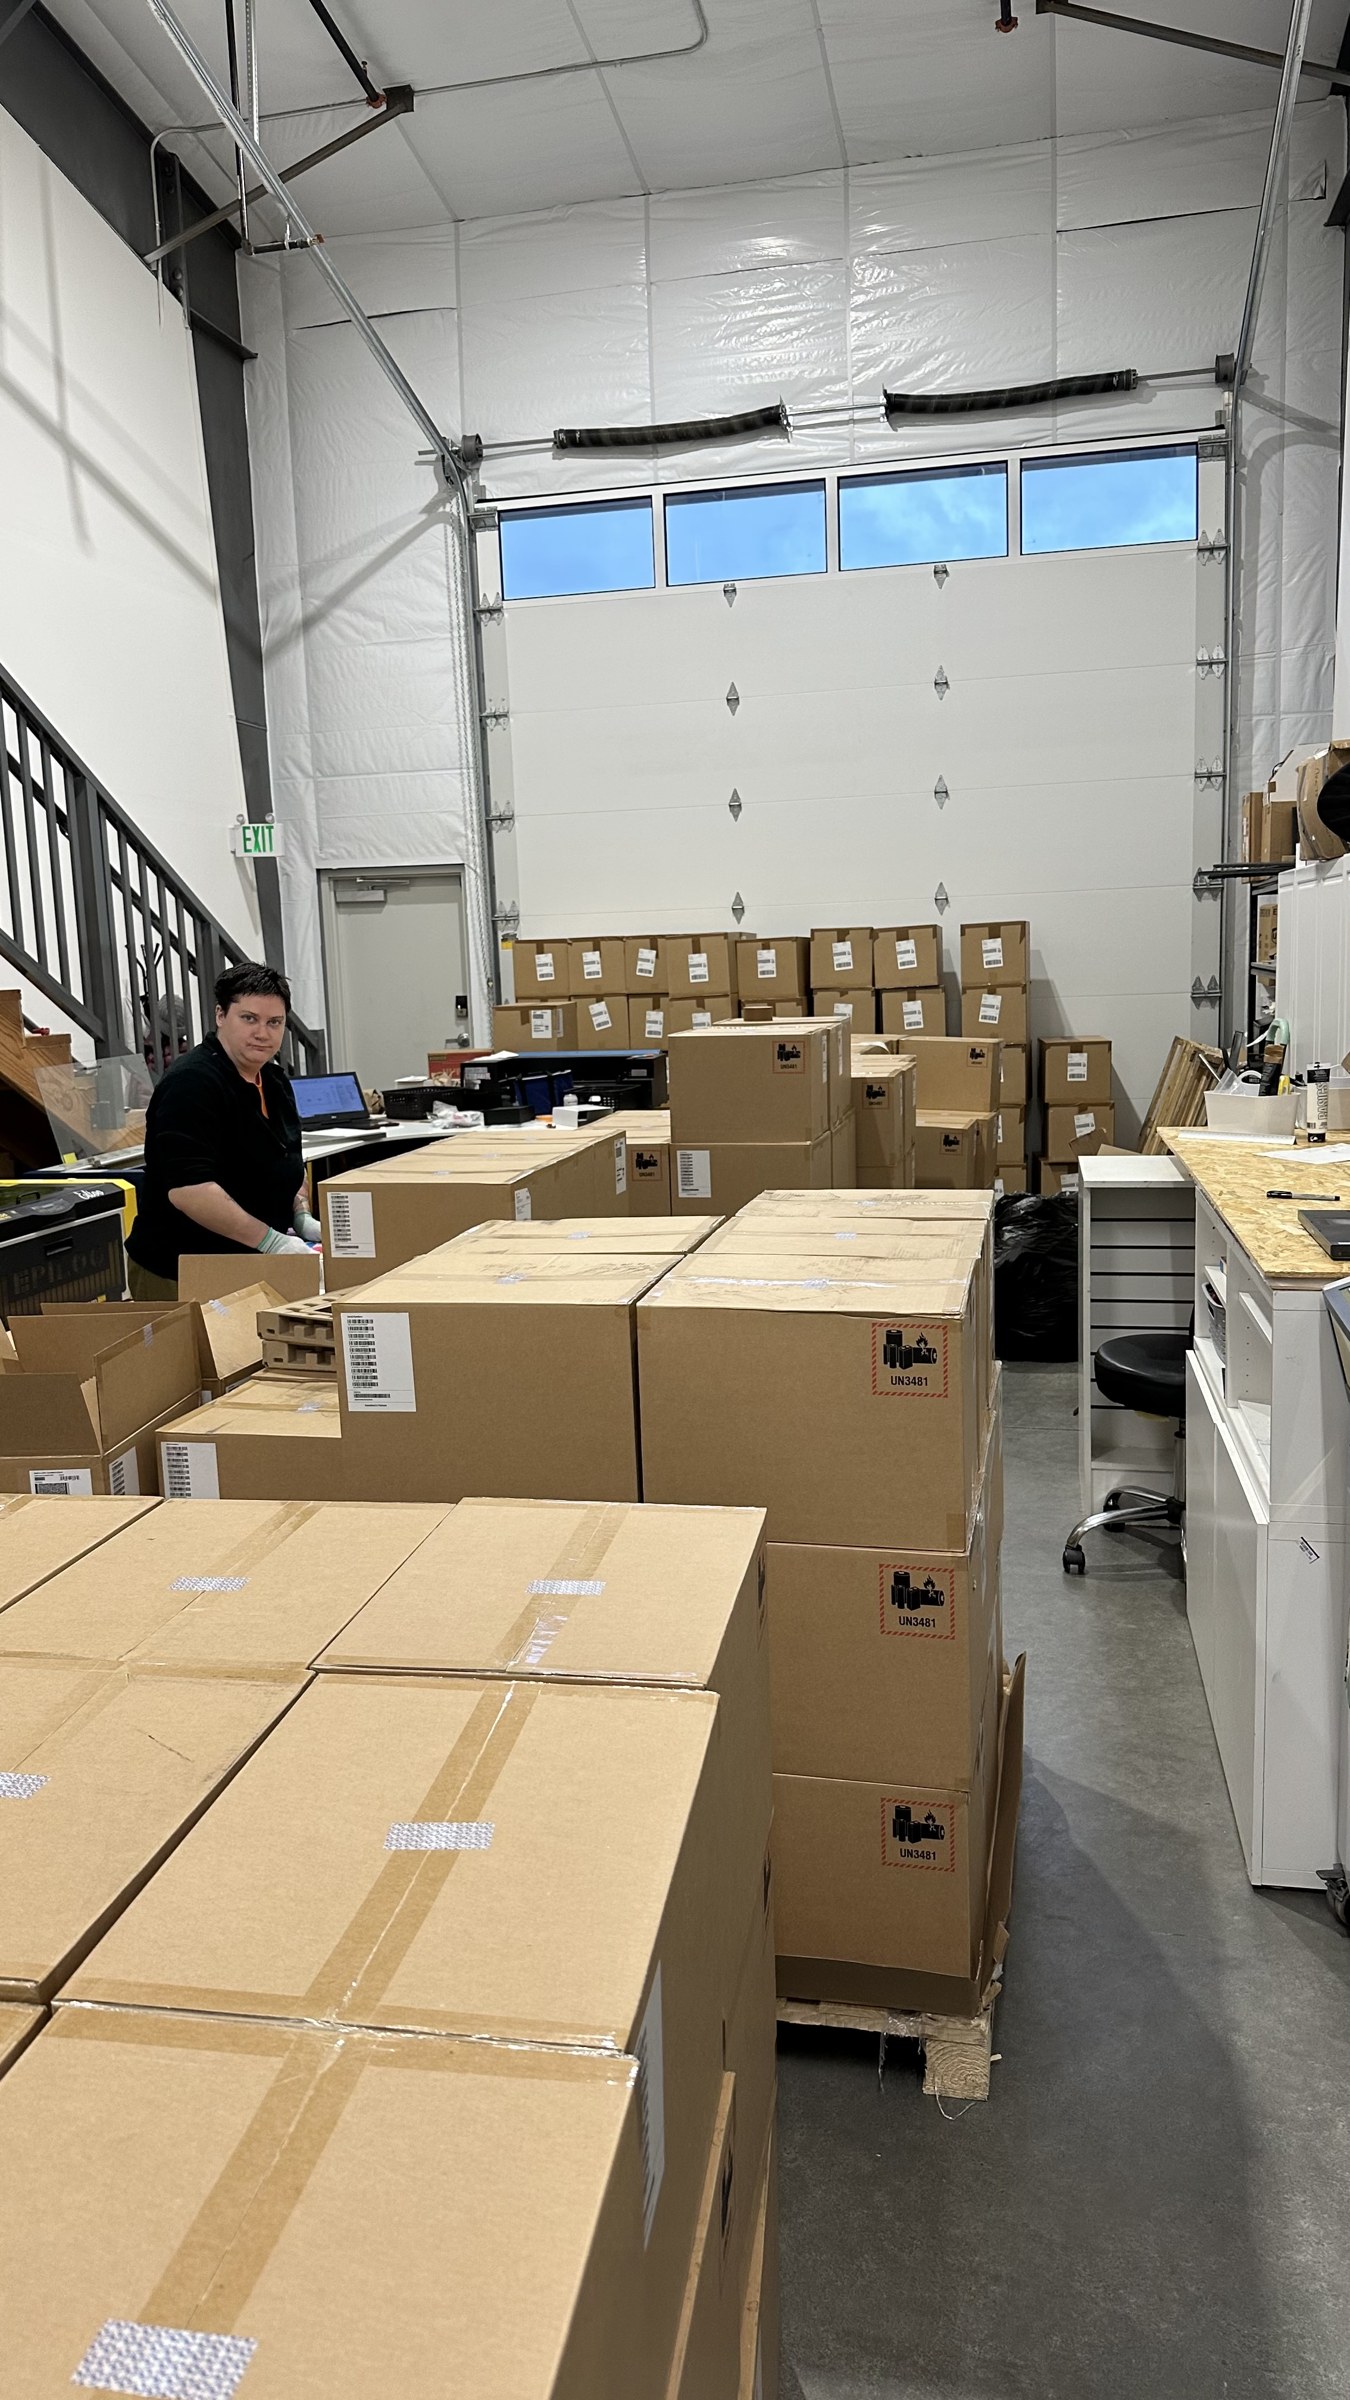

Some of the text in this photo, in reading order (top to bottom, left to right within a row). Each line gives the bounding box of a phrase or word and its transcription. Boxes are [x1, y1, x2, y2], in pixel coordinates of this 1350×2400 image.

[242, 825, 274, 853] EXIT
[890, 1375, 928, 1387] UN3481
[898, 1616, 936, 1628] UN3481
[900, 1848, 936, 1860] UN3481
